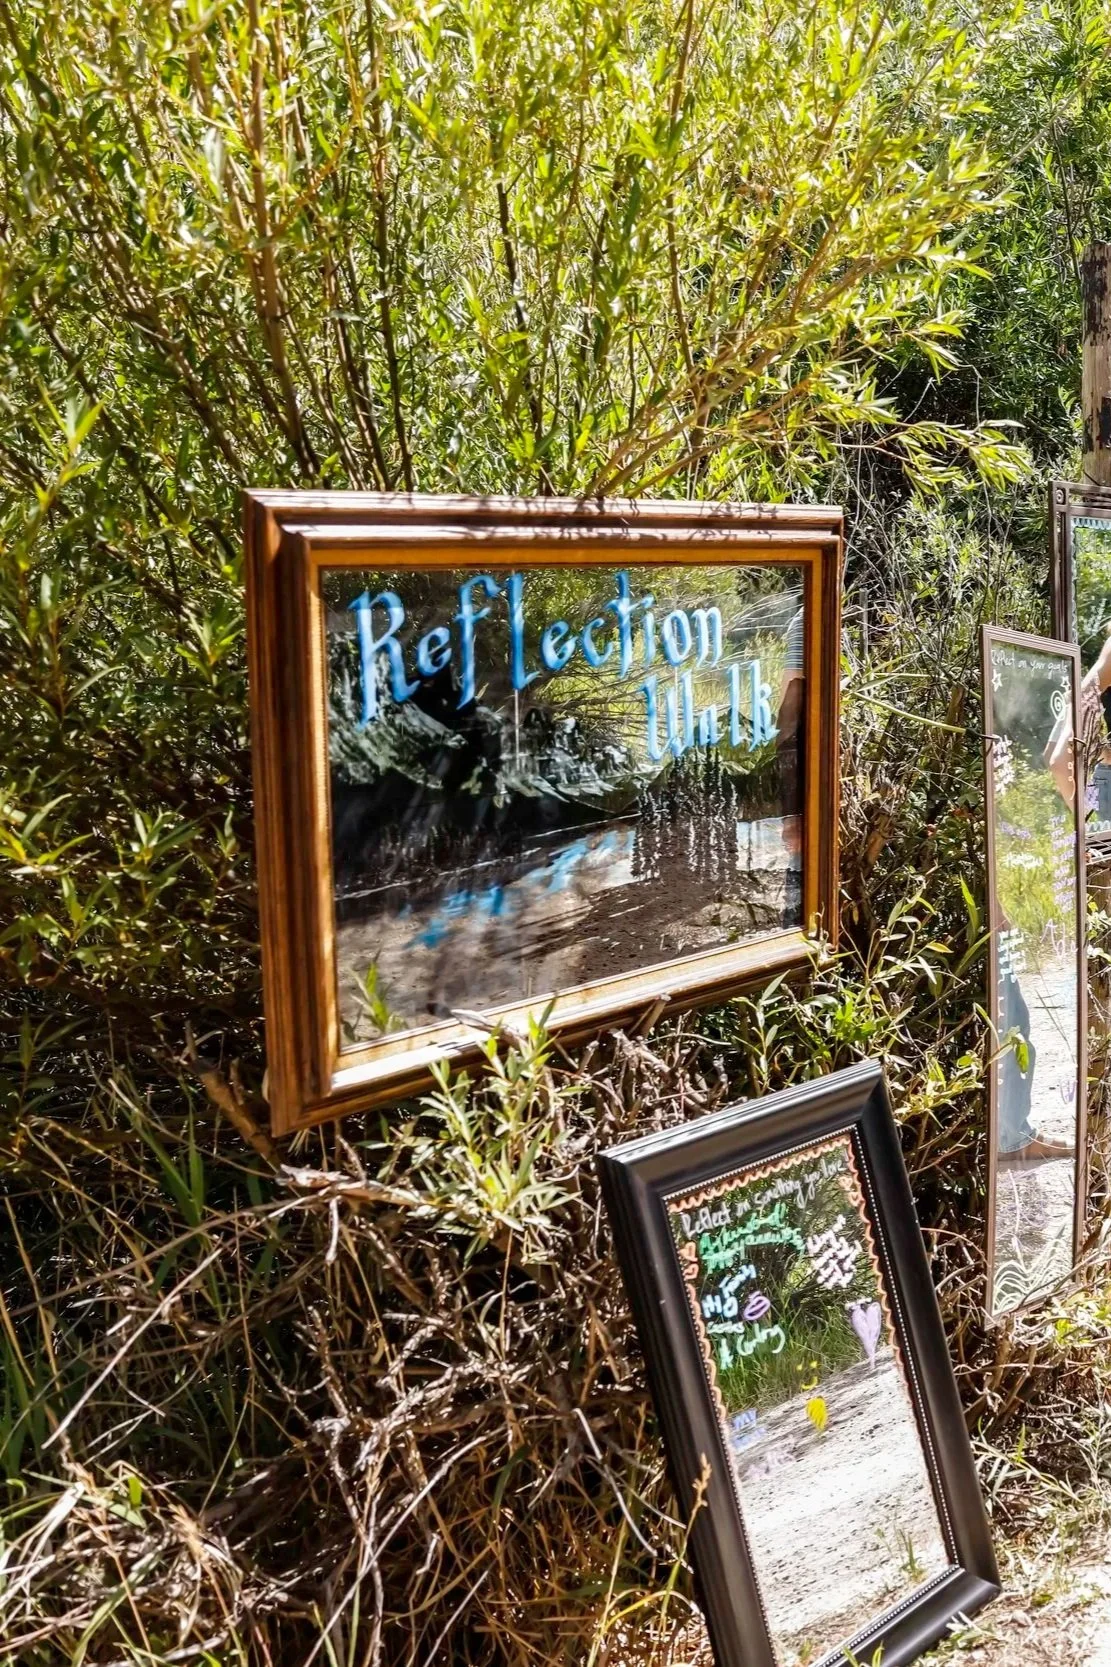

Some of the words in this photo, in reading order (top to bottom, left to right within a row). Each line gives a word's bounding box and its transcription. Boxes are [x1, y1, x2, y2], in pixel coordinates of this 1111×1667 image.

[349, 570, 722, 731] Reflection
[682, 1206, 732, 1237] Reflect
[736, 1197, 751, 1215] on
[754, 1177, 806, 1210] something
